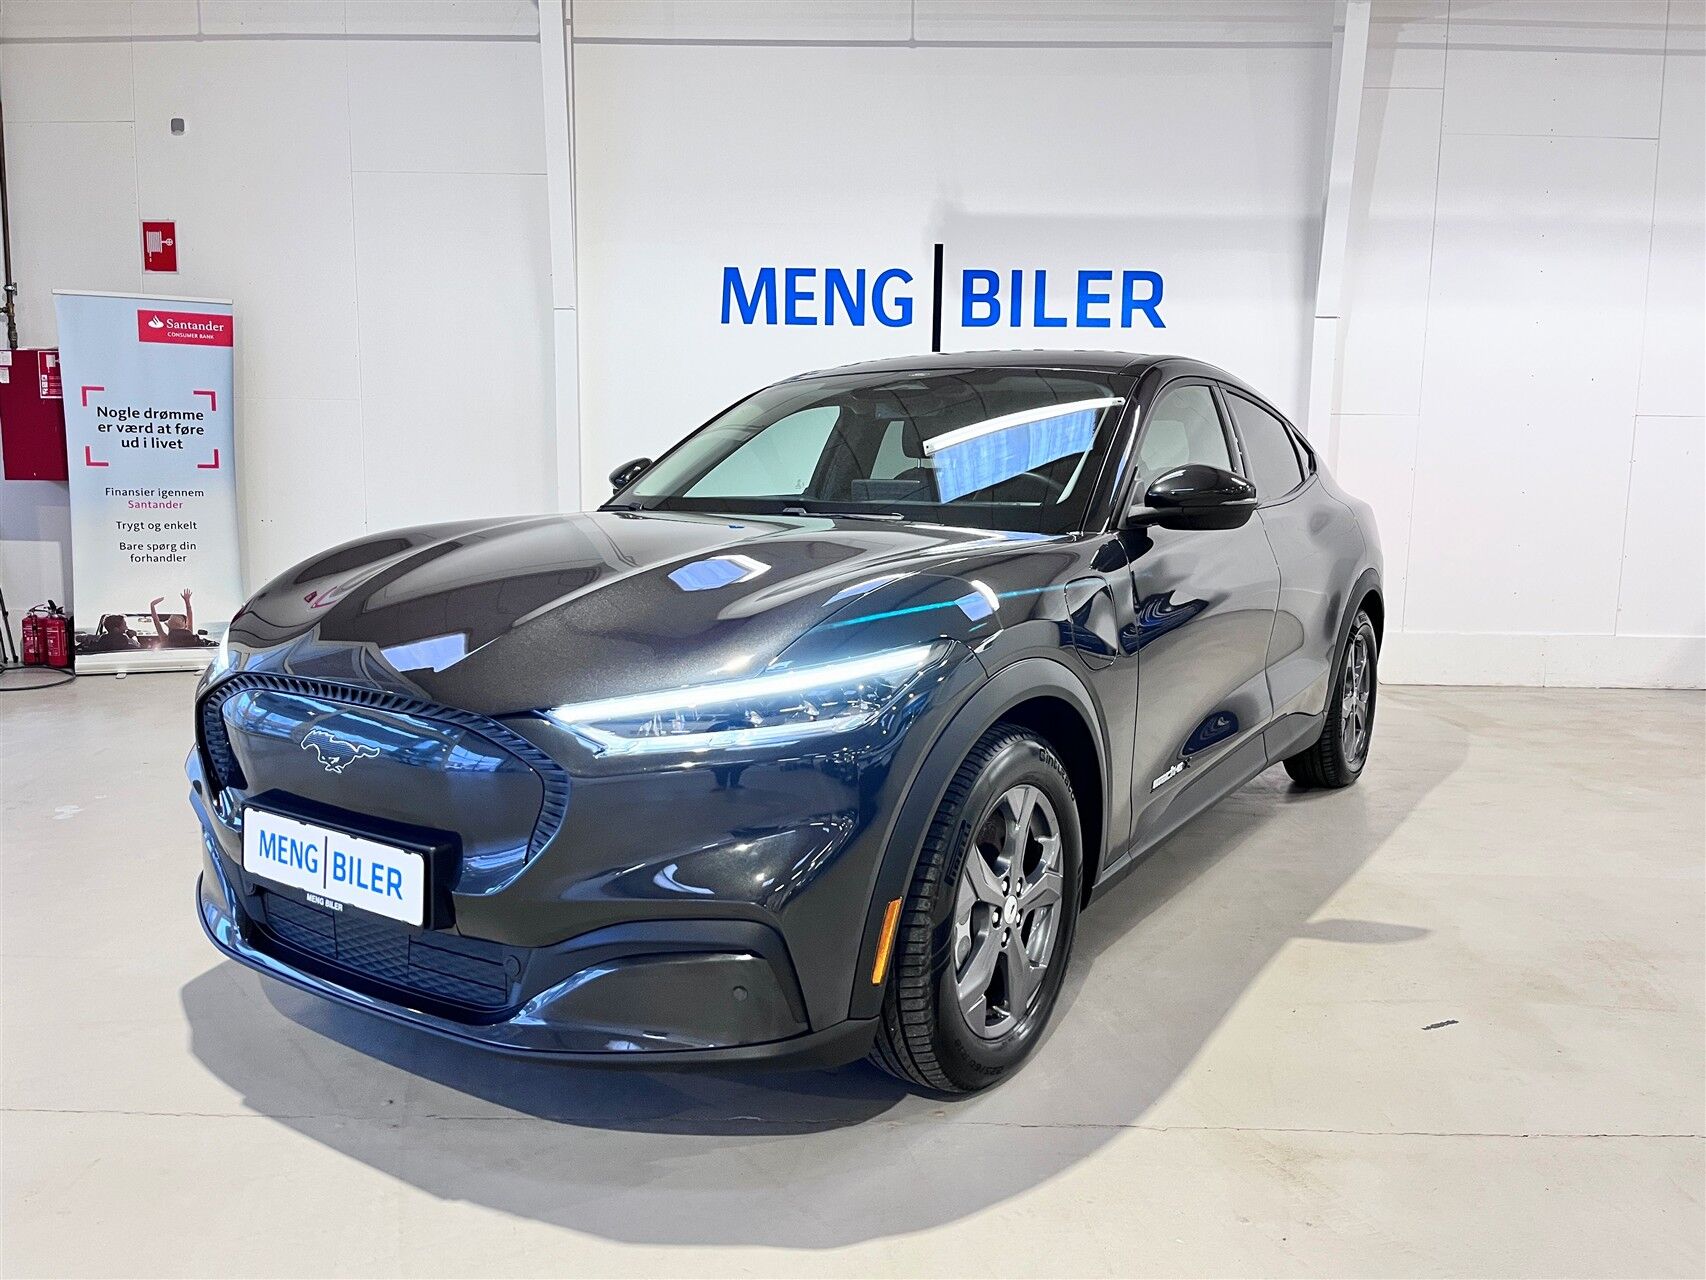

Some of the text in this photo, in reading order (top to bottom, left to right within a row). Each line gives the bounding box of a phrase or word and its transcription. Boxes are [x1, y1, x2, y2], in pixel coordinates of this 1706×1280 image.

[720, 266, 1167, 329] MENG BILER
[166, 318, 224, 332] Santander
[167, 331, 198, 339] CONSUMER
[97, 406, 204, 422] Nogle drømme
[97, 422, 204, 436] er værd at føre
[121, 436, 183, 450] ud i livet
[105, 487, 205, 500] Finansier igennem
[128, 500, 183, 509] Santander
[116, 521, 198, 533] Trygt og enkelt
[119, 541, 197, 553] Bare spørg din
[130, 553, 187, 563] forhandler
[259, 829, 403, 901] MENG BILER
[306, 893, 344, 912] MENG BILER
